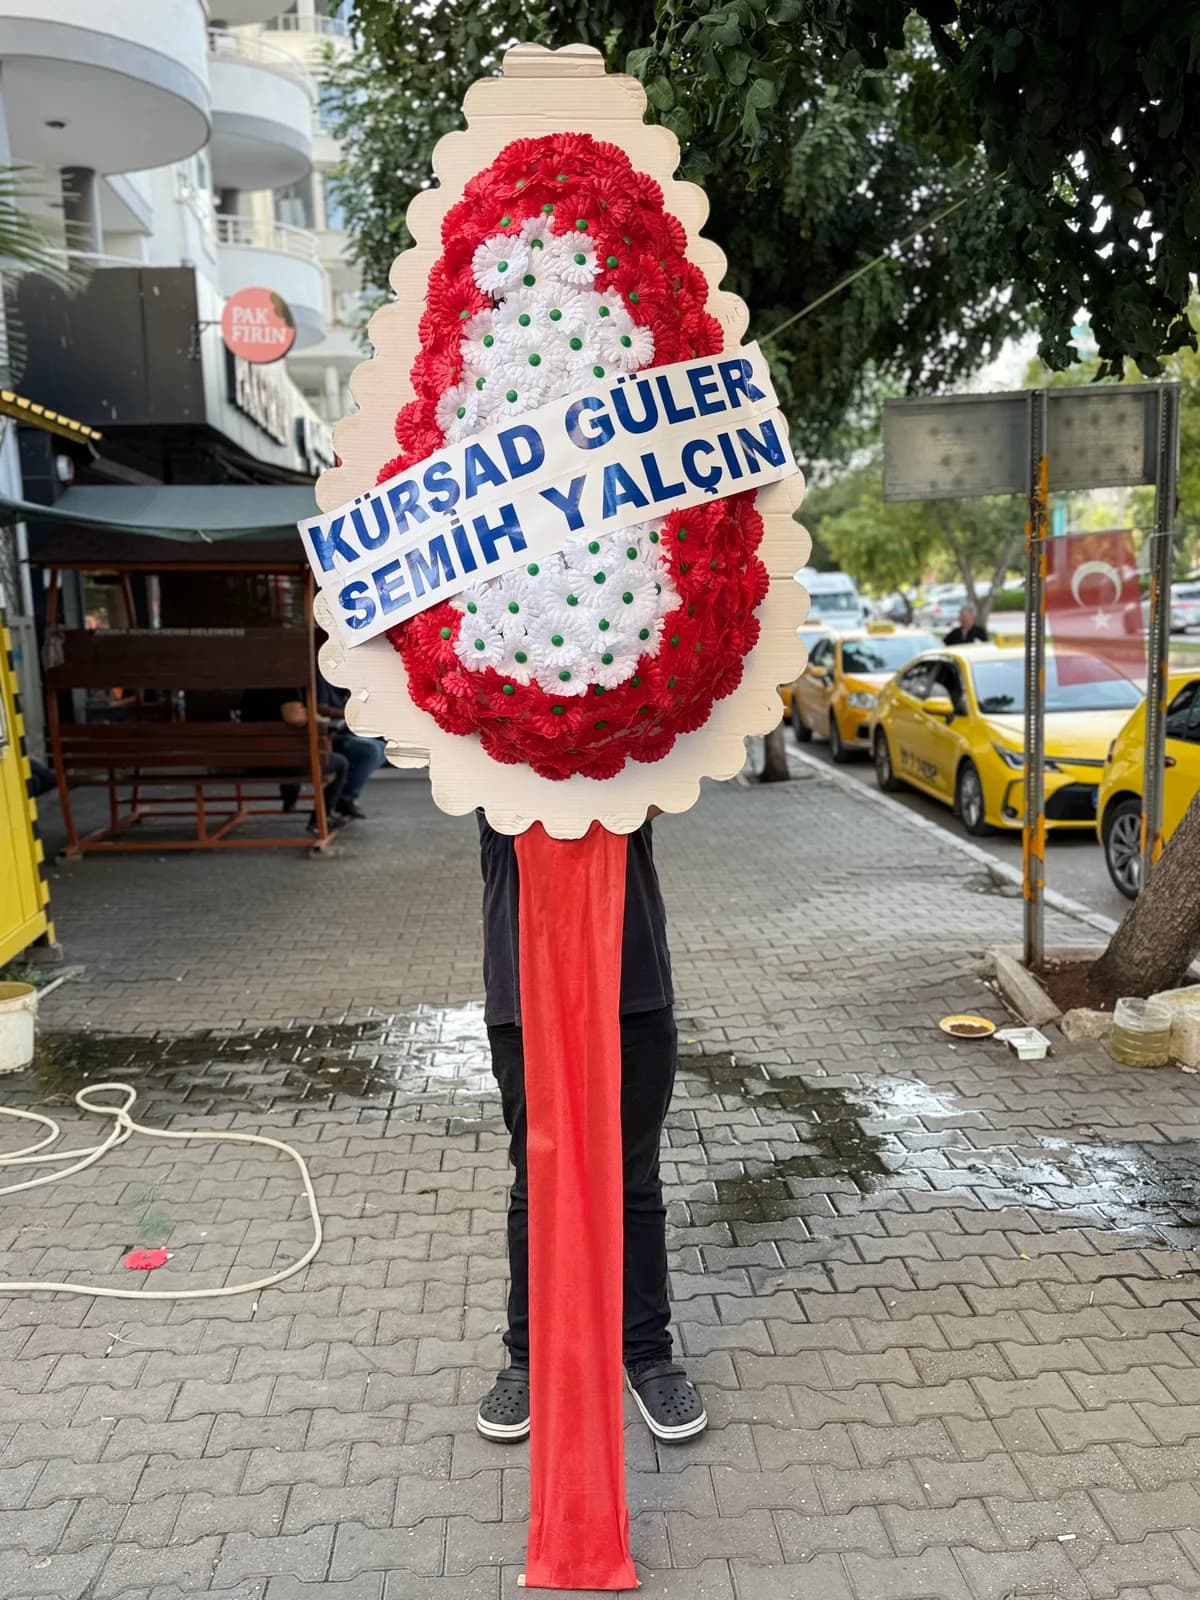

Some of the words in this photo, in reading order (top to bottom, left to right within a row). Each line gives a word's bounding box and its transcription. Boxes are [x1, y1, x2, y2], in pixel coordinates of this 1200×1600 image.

[231, 306, 269, 325] PAK
[231, 325, 286, 344] FIRIN
[308, 425, 545, 572] KÜRŞAD
[565, 359, 766, 450] GÜLER
[338, 503, 528, 630] SEMİH
[538, 419, 786, 531] YALÇIN
